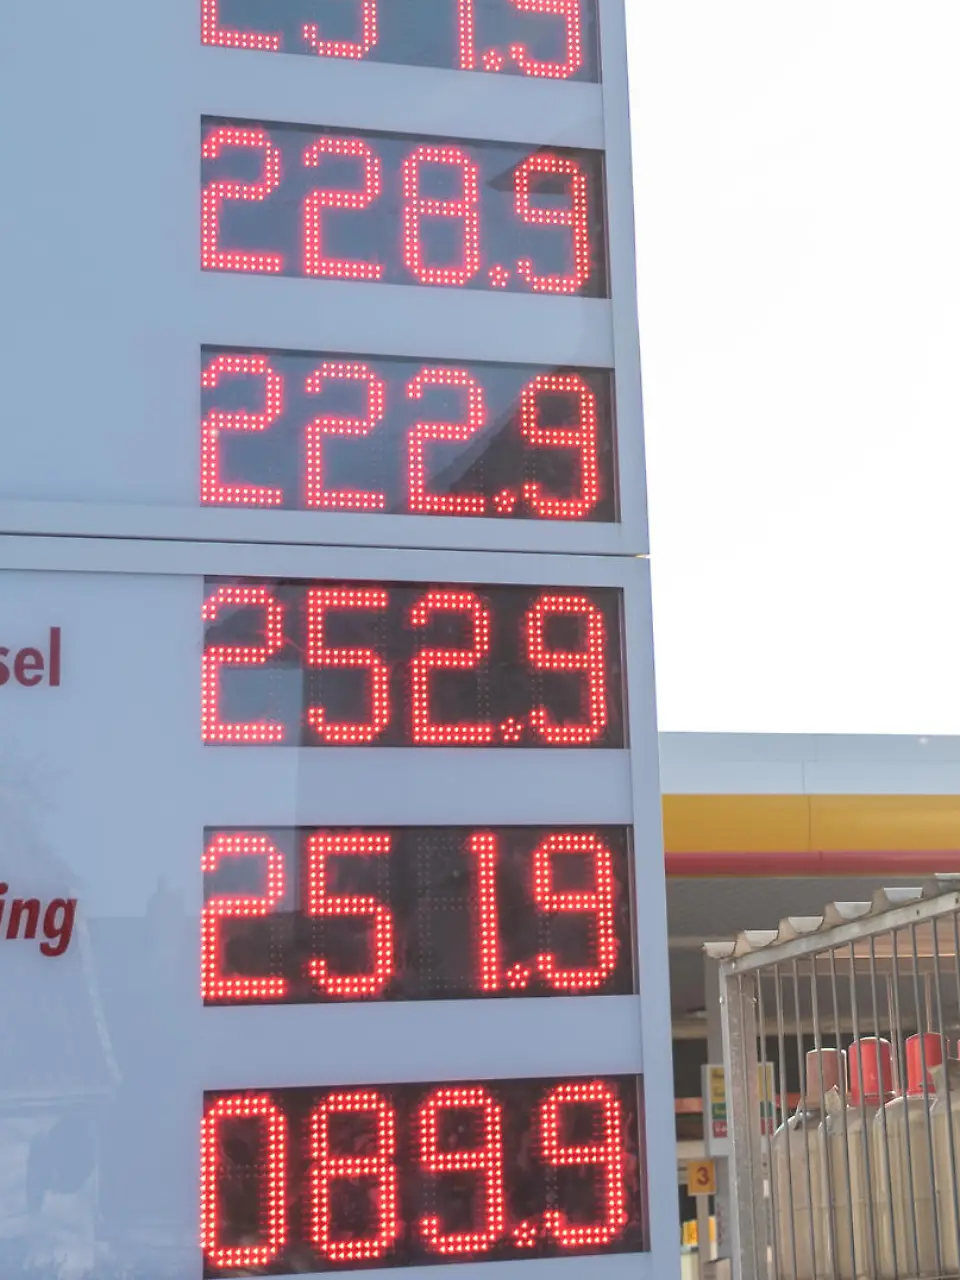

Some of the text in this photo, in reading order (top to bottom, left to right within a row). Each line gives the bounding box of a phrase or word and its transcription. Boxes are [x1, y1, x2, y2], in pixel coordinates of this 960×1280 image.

[200, 127, 590, 294] 228.9
[200, 354, 600, 518] 222.9
[200, 585, 607, 744] 252.9
[200, 832, 621, 1000] 251.9
[199, 1080, 629, 1268] 089.9
[696, 1166, 710, 1187] 3
